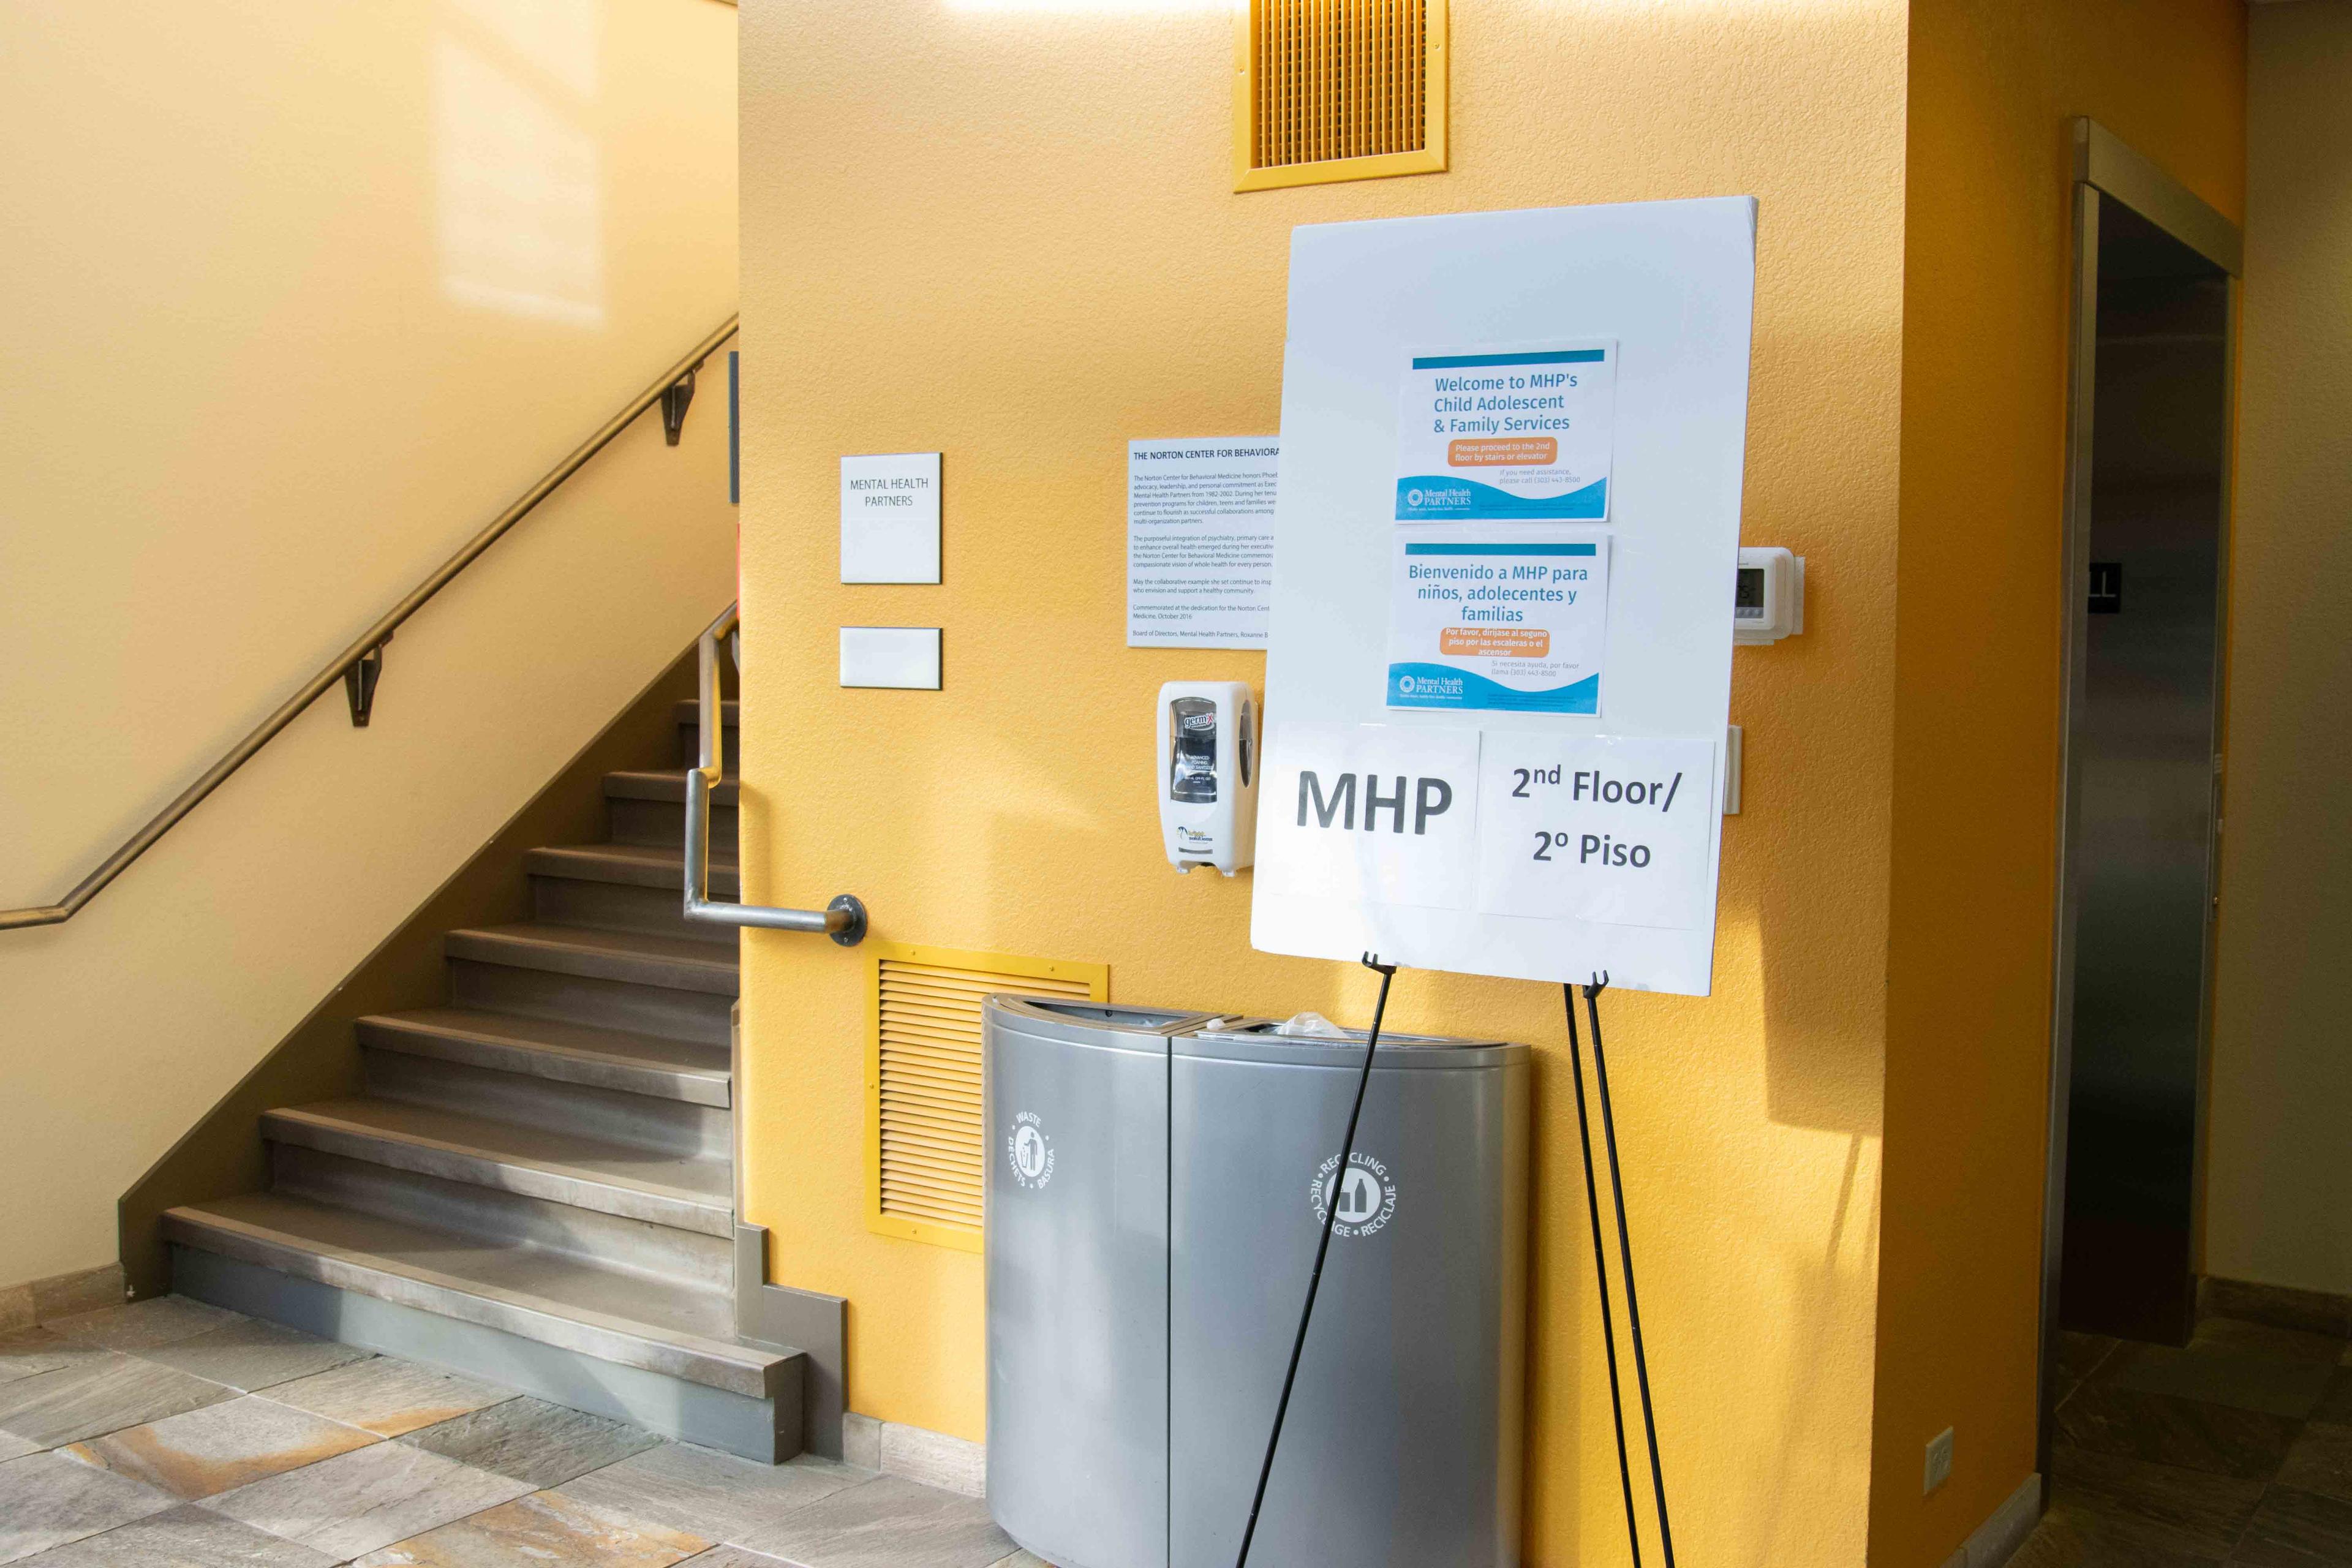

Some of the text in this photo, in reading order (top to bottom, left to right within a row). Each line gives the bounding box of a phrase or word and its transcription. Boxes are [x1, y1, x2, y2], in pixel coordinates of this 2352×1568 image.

[1435, 373, 1577, 391] Welcome to MHP's
[1434, 395, 1564, 412] Child Adolescent
[1434, 415, 1570, 434] & Family Services
[1150, 451, 1183, 459] NORTON
[1185, 450, 1215, 459] CENTER
[1217, 449, 1233, 458] FOR
[1480, 443, 1510, 452] proceed
[1474, 453, 1483, 462] by
[1485, 453, 1505, 461] stairs
[851, 478, 928, 490] MENTAL HEALTH
[1499, 477, 1520, 485] please
[865, 496, 913, 507] PARTNERS
[1425, 497, 1471, 506] PARTNERS
[1409, 564, 1588, 583] Bienvenido a MHP para
[1418, 584, 1577, 605] niños, adolecentes y
[1461, 606, 1523, 622] familias
[1449, 638, 1464, 646] piso
[1416, 685, 1463, 694] PARTNERS
[1417, 676, 1463, 686] Mental Health
[1512, 764, 1683, 812] 2nd Floor/
[1297, 771, 1452, 834] MHP
[1580, 834, 1651, 868] Piso
[1016, 1111, 1042, 1128] WASTE
[1037, 1148, 1055, 1189] BASURA
[1320, 1152, 1387, 1177] RECCLING
[1360, 1185, 1396, 1237] RECICLAJE
